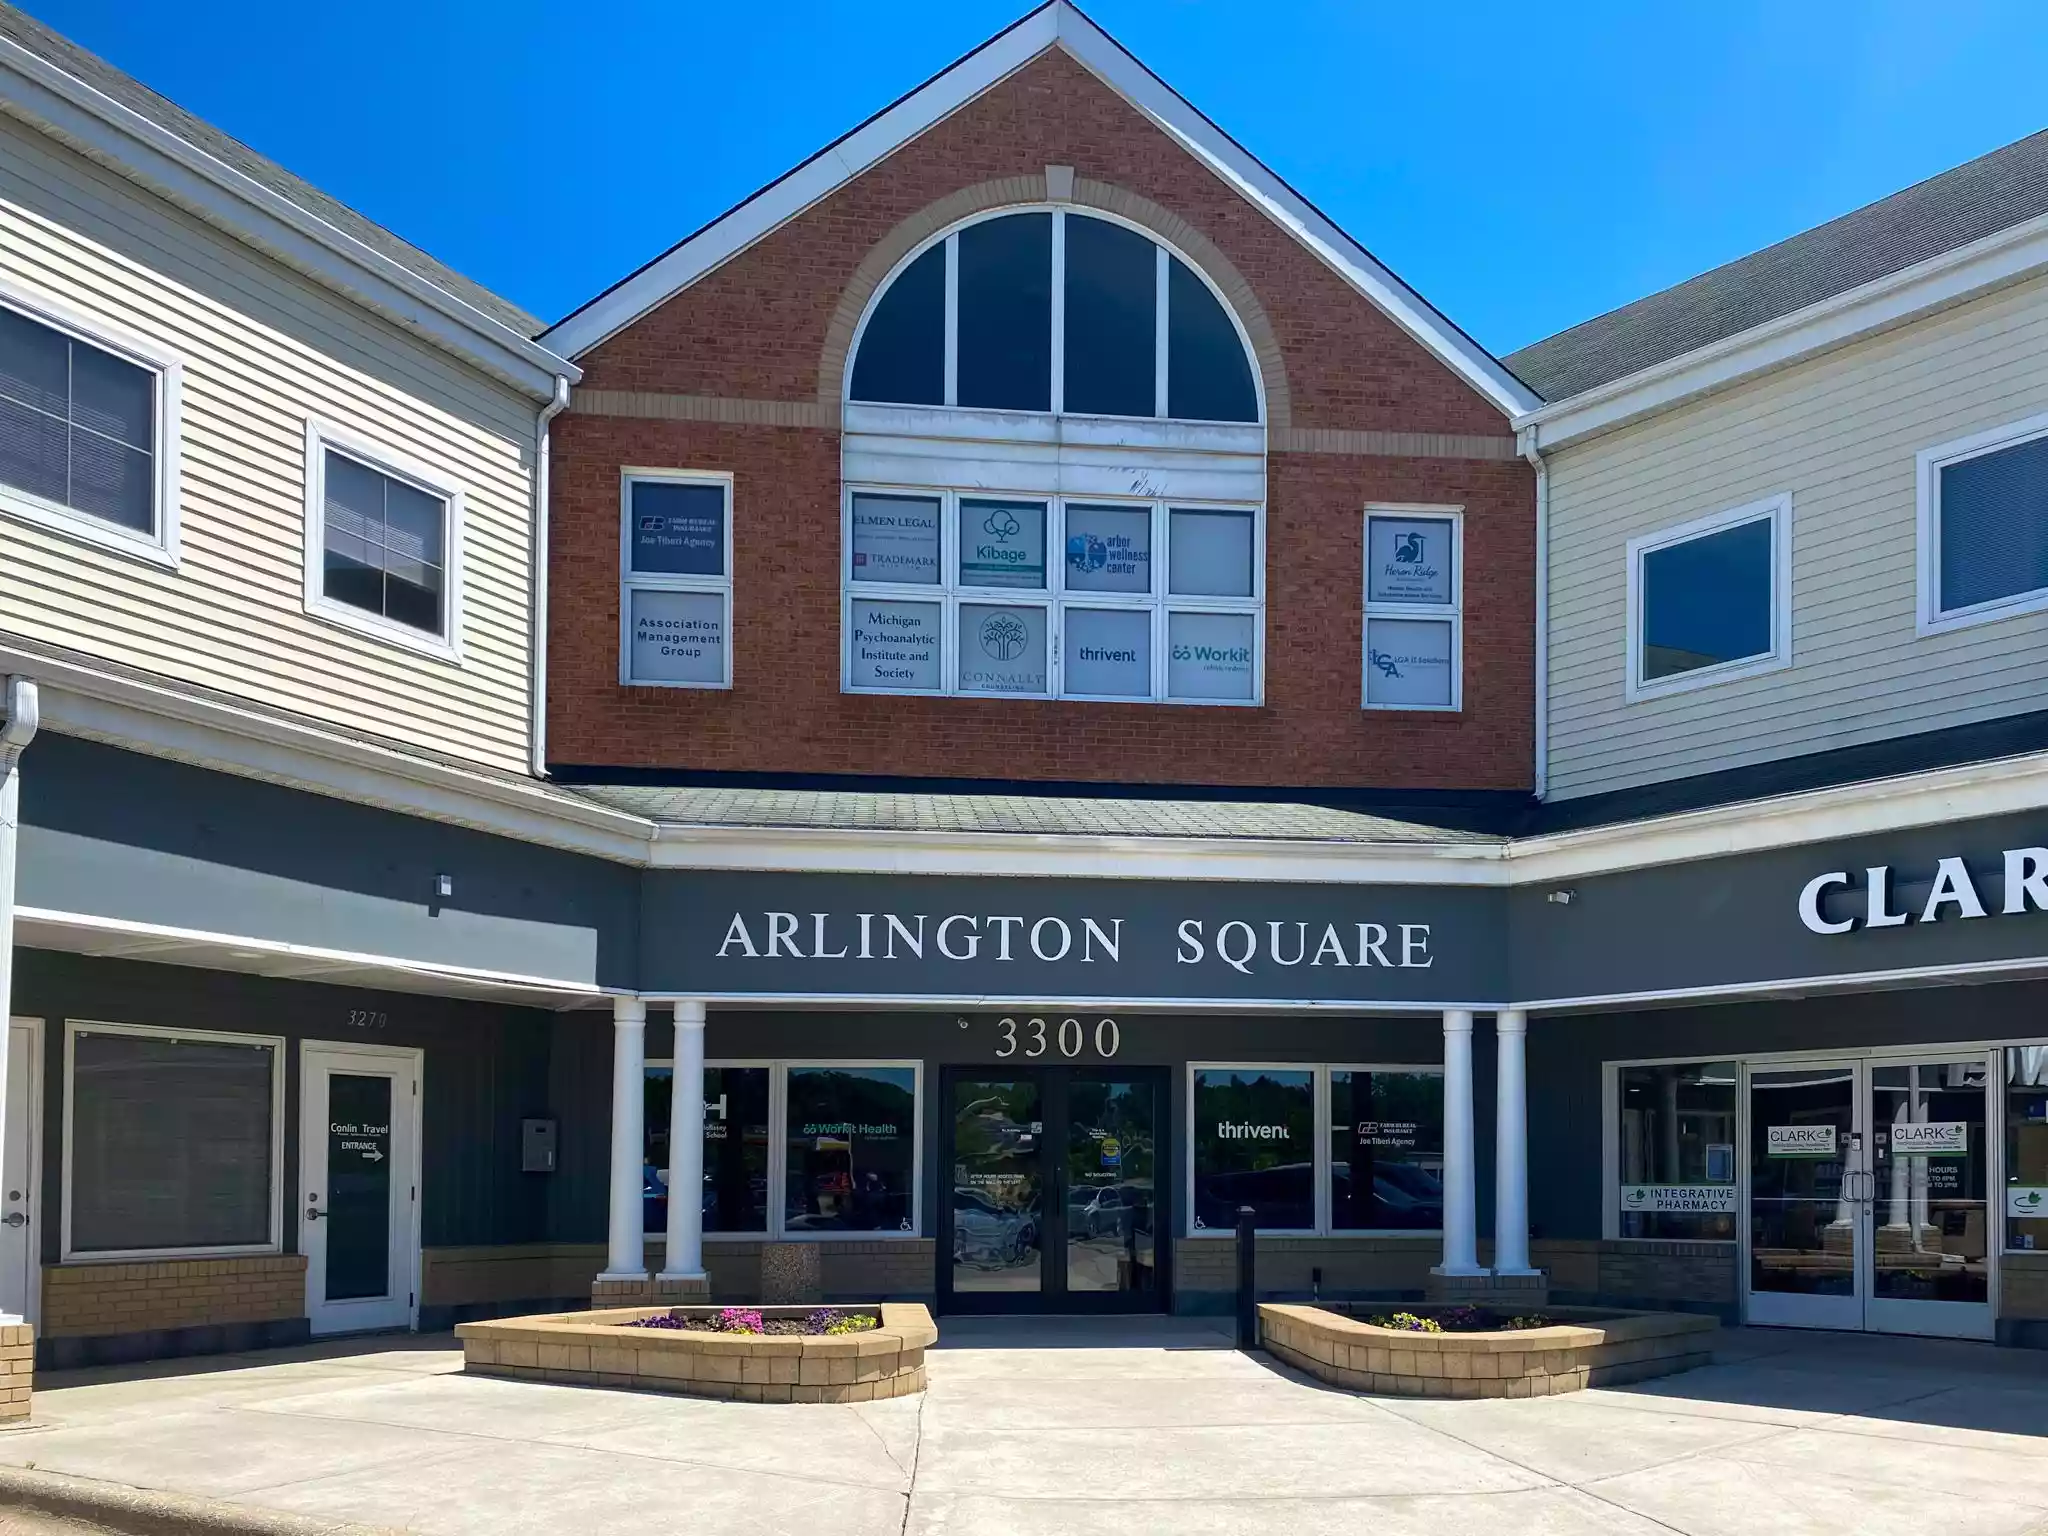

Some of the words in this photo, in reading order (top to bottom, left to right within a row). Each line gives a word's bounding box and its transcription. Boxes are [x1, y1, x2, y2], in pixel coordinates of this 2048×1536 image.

[898, 518, 935, 528] LEGAL
[1107, 535, 1130, 547] arbor
[871, 553, 936, 566] TRADEMARK
[976, 546, 1026, 563] Kibage
[1109, 548, 1148, 561] wellness
[1107, 562, 1136, 574] center
[640, 618, 718, 630] Association
[868, 612, 921, 628] Michigan
[638, 632, 720, 644] Management
[855, 629, 935, 645] Psychoanalytic
[661, 646, 701, 658] Group
[861, 648, 906, 660] Institute
[909, 652, 929, 661] and
[1080, 647, 1136, 662] thrivent
[1194, 646, 1250, 662] Workit
[875, 665, 914, 680] Society
[1798, 846, 2048, 934] CLAR
[715, 911, 1125, 963] ARLINGTON
[1177, 919, 1434, 975] SQUARE
[348, 1010, 387, 1028] 3270
[995, 1017, 1120, 1057] 3300
[331, 1123, 357, 1133] Conlin
[362, 1124, 388, 1134] Travel
[859, 1123, 897, 1134] Health
[1218, 1121, 1290, 1139] thrivent
[1894, 1128, 1945, 1140] CLARK
[1770, 1130, 1816, 1142] CLARK
[341, 1141, 377, 1150] ENTRANCE
[1650, 1188, 1734, 1199] INTEGRATIVE
[1657, 1200, 1728, 1210] PHARMACY
